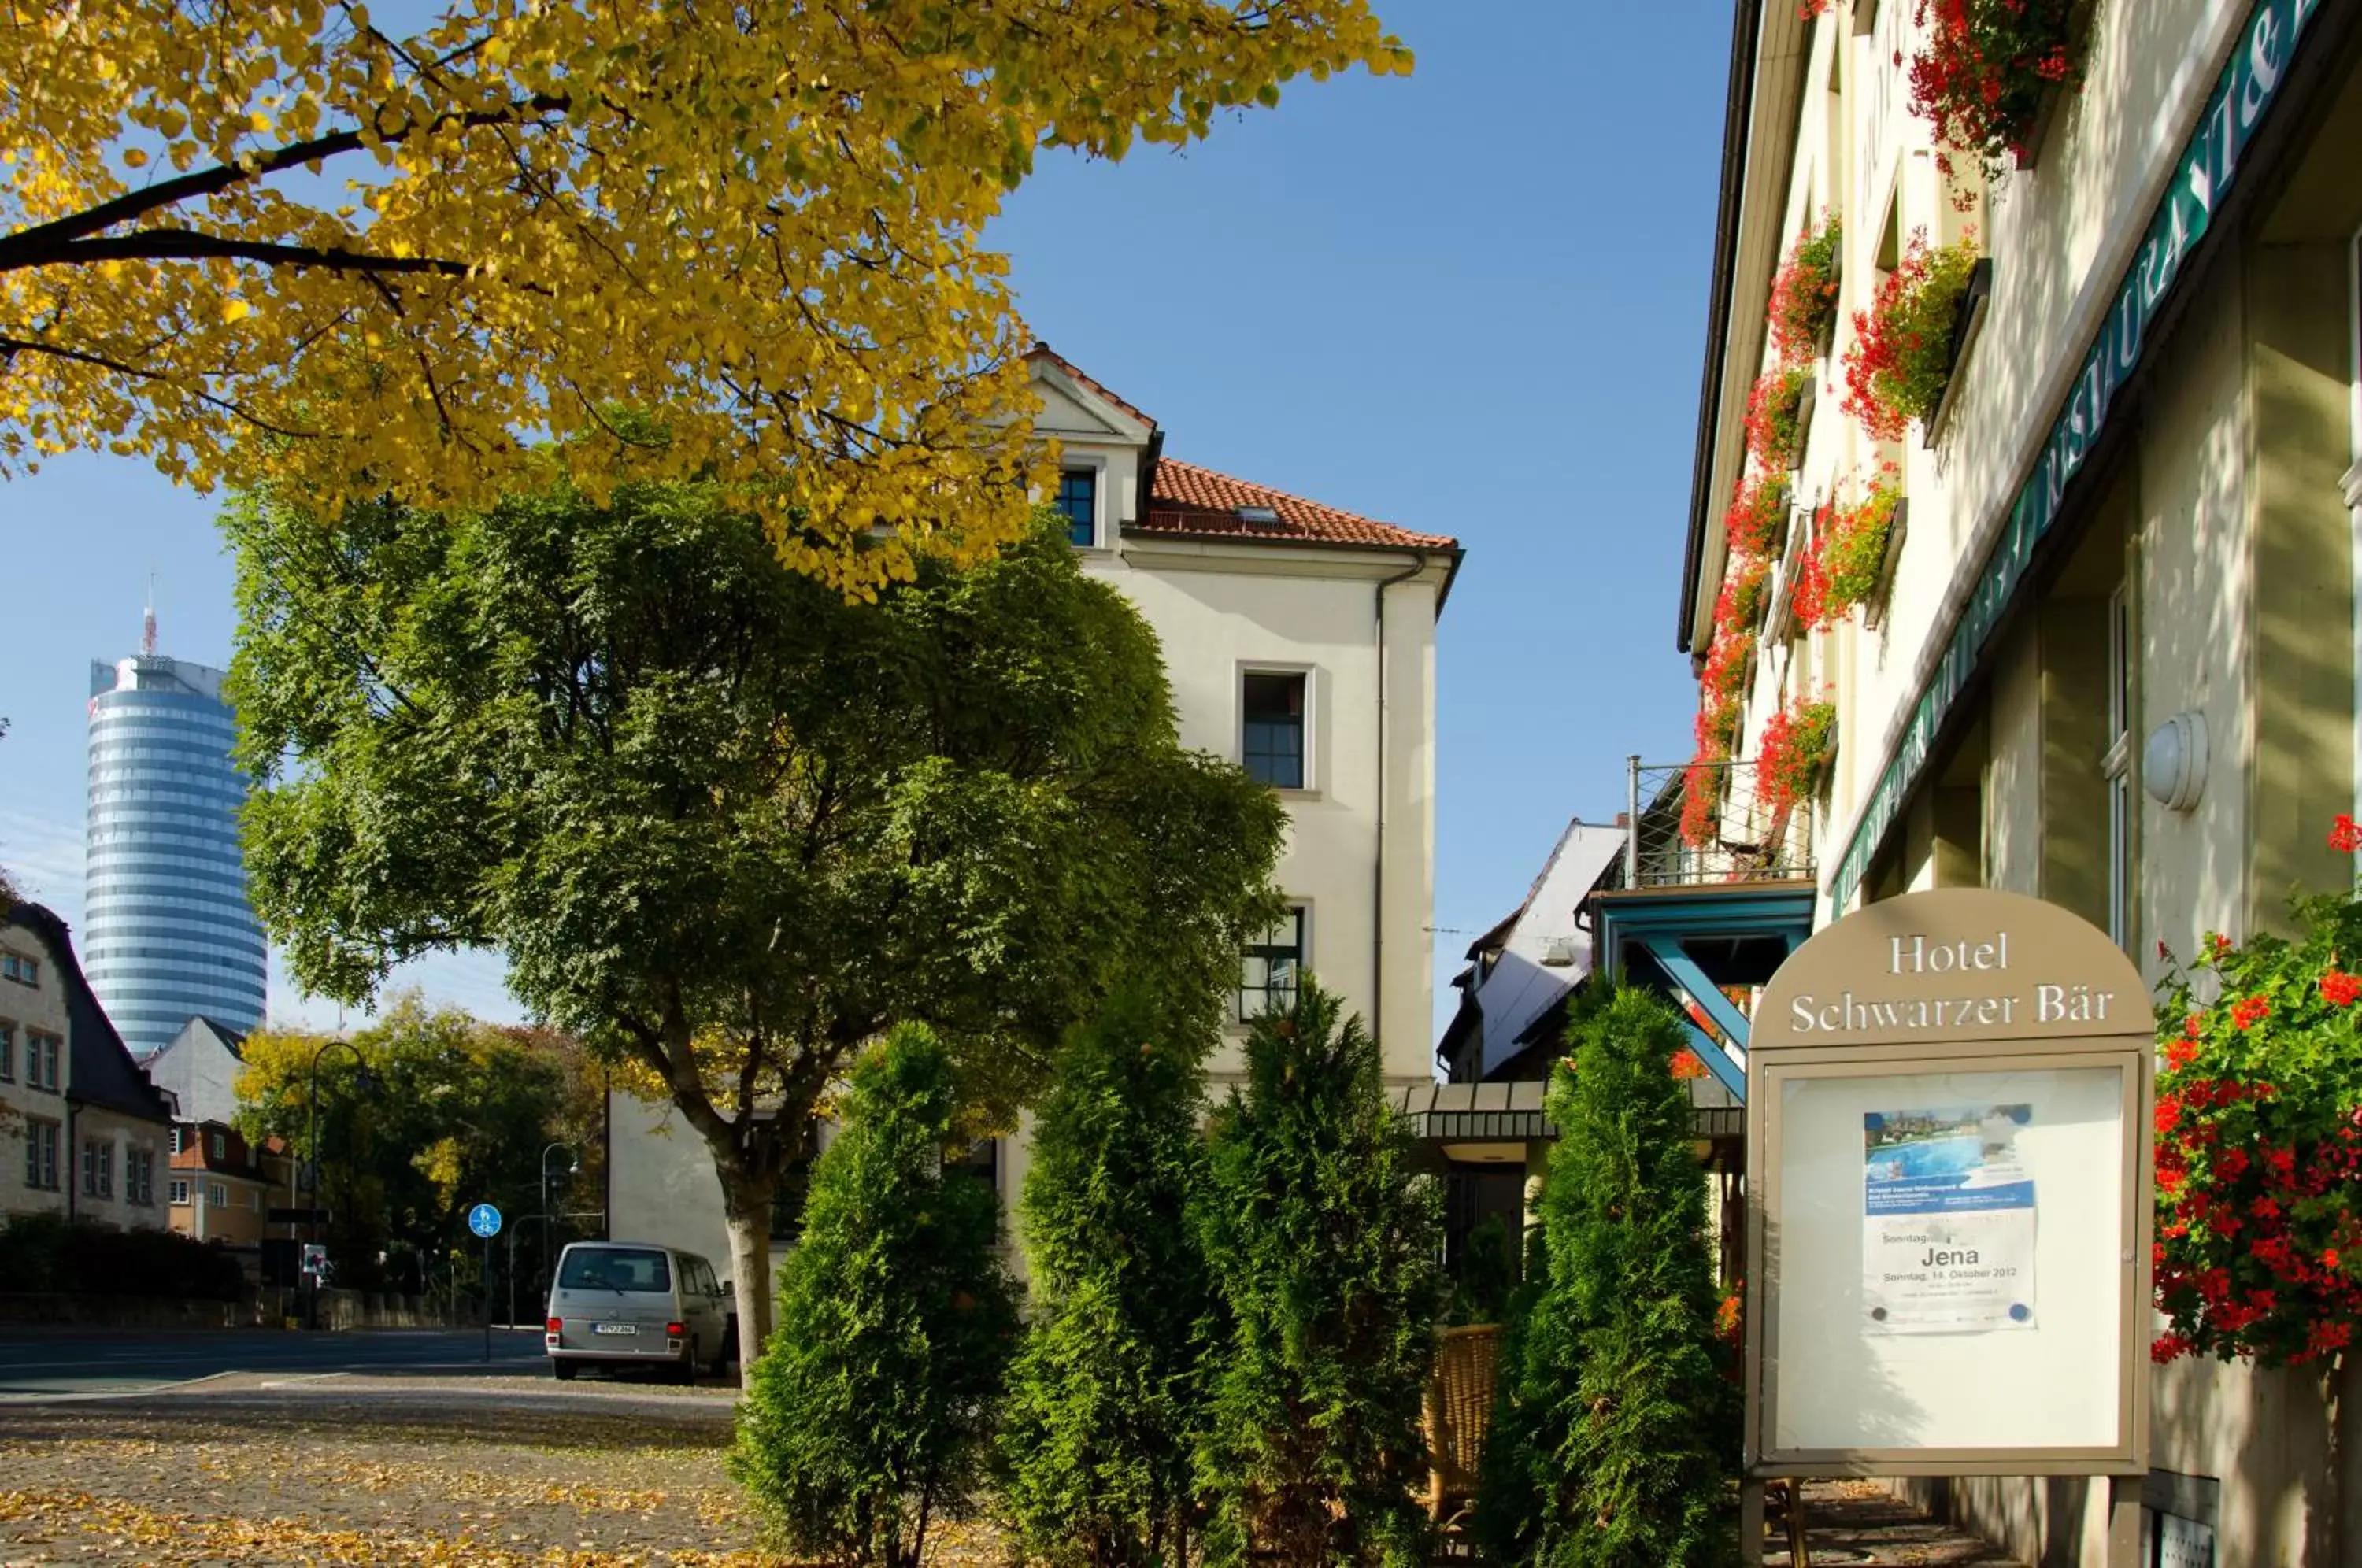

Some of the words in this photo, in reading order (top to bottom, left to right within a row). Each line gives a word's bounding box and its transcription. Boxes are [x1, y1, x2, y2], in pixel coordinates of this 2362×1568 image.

[1886, 930, 2008, 974] Hotel
[1790, 990, 2020, 1033] Schwarzer
[2034, 983, 2116, 1023] Bär
[1922, 1248, 1979, 1267] Jena
[1949, 1268, 1991, 1279] Oktober
[1992, 1267, 2017, 1278] 2012
